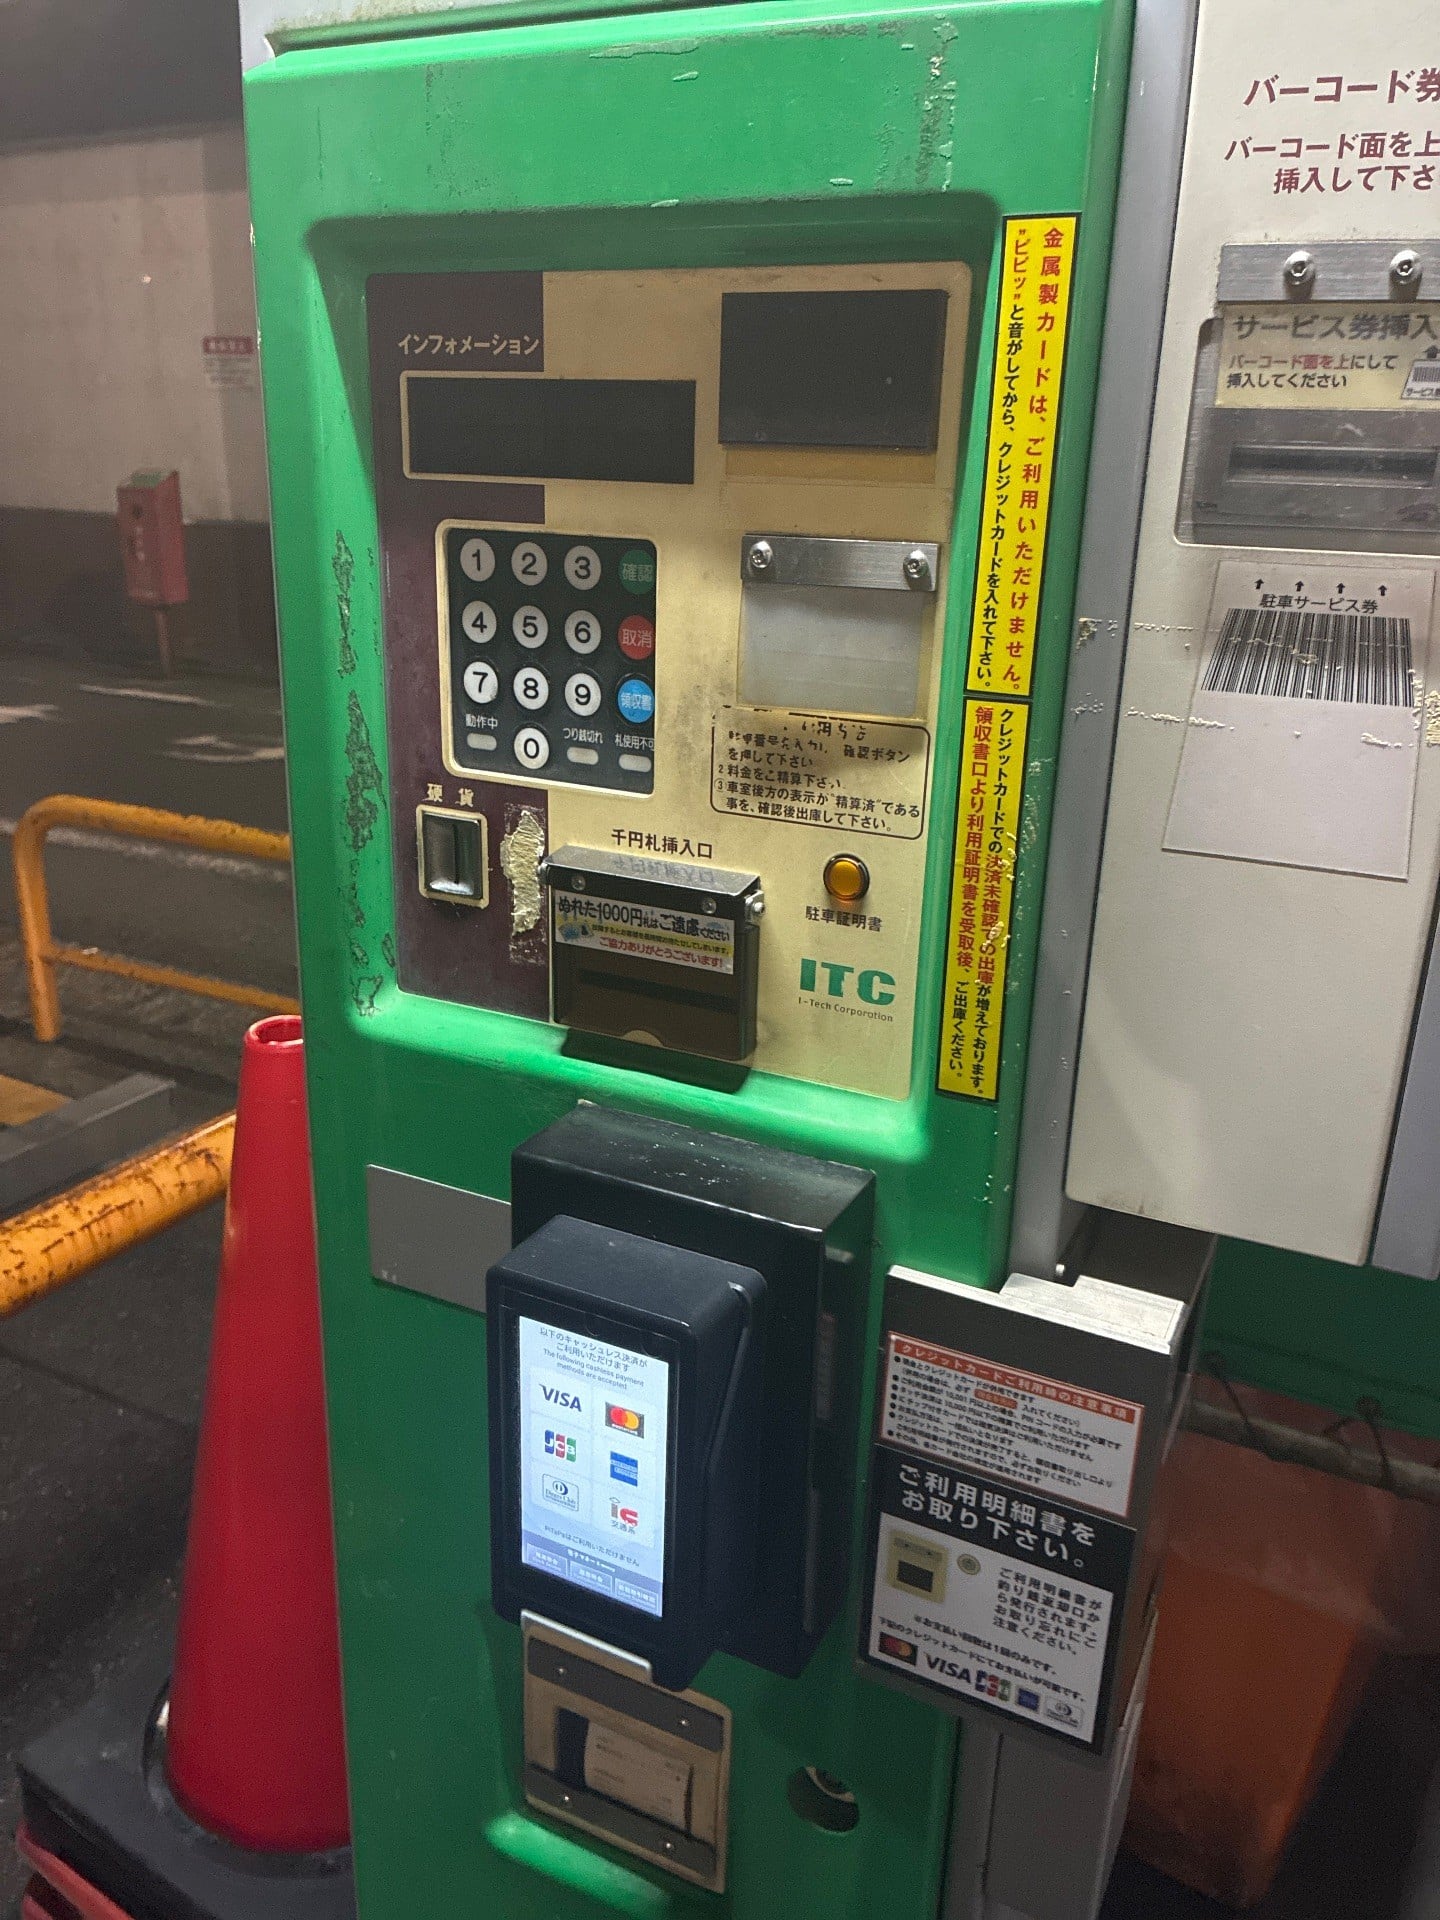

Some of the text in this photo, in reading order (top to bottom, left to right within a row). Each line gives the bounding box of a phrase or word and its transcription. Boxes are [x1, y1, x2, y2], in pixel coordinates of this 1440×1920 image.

[1243, 67, 1440, 106] バーコード券
[1224, 131, 1440, 161] バーコード面を上
[398, 333, 539, 356] インフォメーション
[1228, 353, 1399, 371] バーコード面を上にして
[1226, 372, 1347, 391] 挿入してください
[1002, 228, 1064, 690] 金属製カードは、ご利用いただけません。
[472, 548, 482, 572] 1
[522, 552, 538, 576] 2
[574, 556, 591, 580] 3
[622, 563, 652, 583] 確認
[1259, 593, 1378, 614] 駐車サービス券
[471, 611, 488, 634] 4
[522, 615, 539, 639] 5
[574, 620, 592, 644] 6
[622, 628, 653, 649] 取消
[472, 671, 489, 694] 7
[523, 677, 539, 700] 8
[574, 683, 592, 706] 9
[620, 692, 653, 711] 領収書
[465, 713, 498, 730] 動作中
[563, 727, 603, 745] つり銭切れ
[614, 733, 656, 751] 札使用不可
[523, 738, 540, 759] 0
[726, 796, 892, 832] 事を、確認後出庫して下さい。
[611, 828, 713, 860] 千円札挿入口
[805, 906, 883, 932] 駐車証明書
[799, 958, 896, 1007] ITC
[833, 1002, 895, 1022] Corporation
[540, 1327, 648, 1368] 以下のキャッシュレス決済が
[556, 1342, 631, 1372] ご利用いただけます
[543, 1348, 644, 1388] The following cashless payment
[586, 1371, 596, 1379] are
[538, 1383, 582, 1412] VISA
[544, 1429, 577, 1462] JCB
[899, 1463, 1096, 1547] ご利用明細書を
[901, 1490, 1085, 1569] お取り下さい。
[1000, 1566, 1103, 1611] ご利用明細書が
[925, 1652, 972, 1685] VISA
